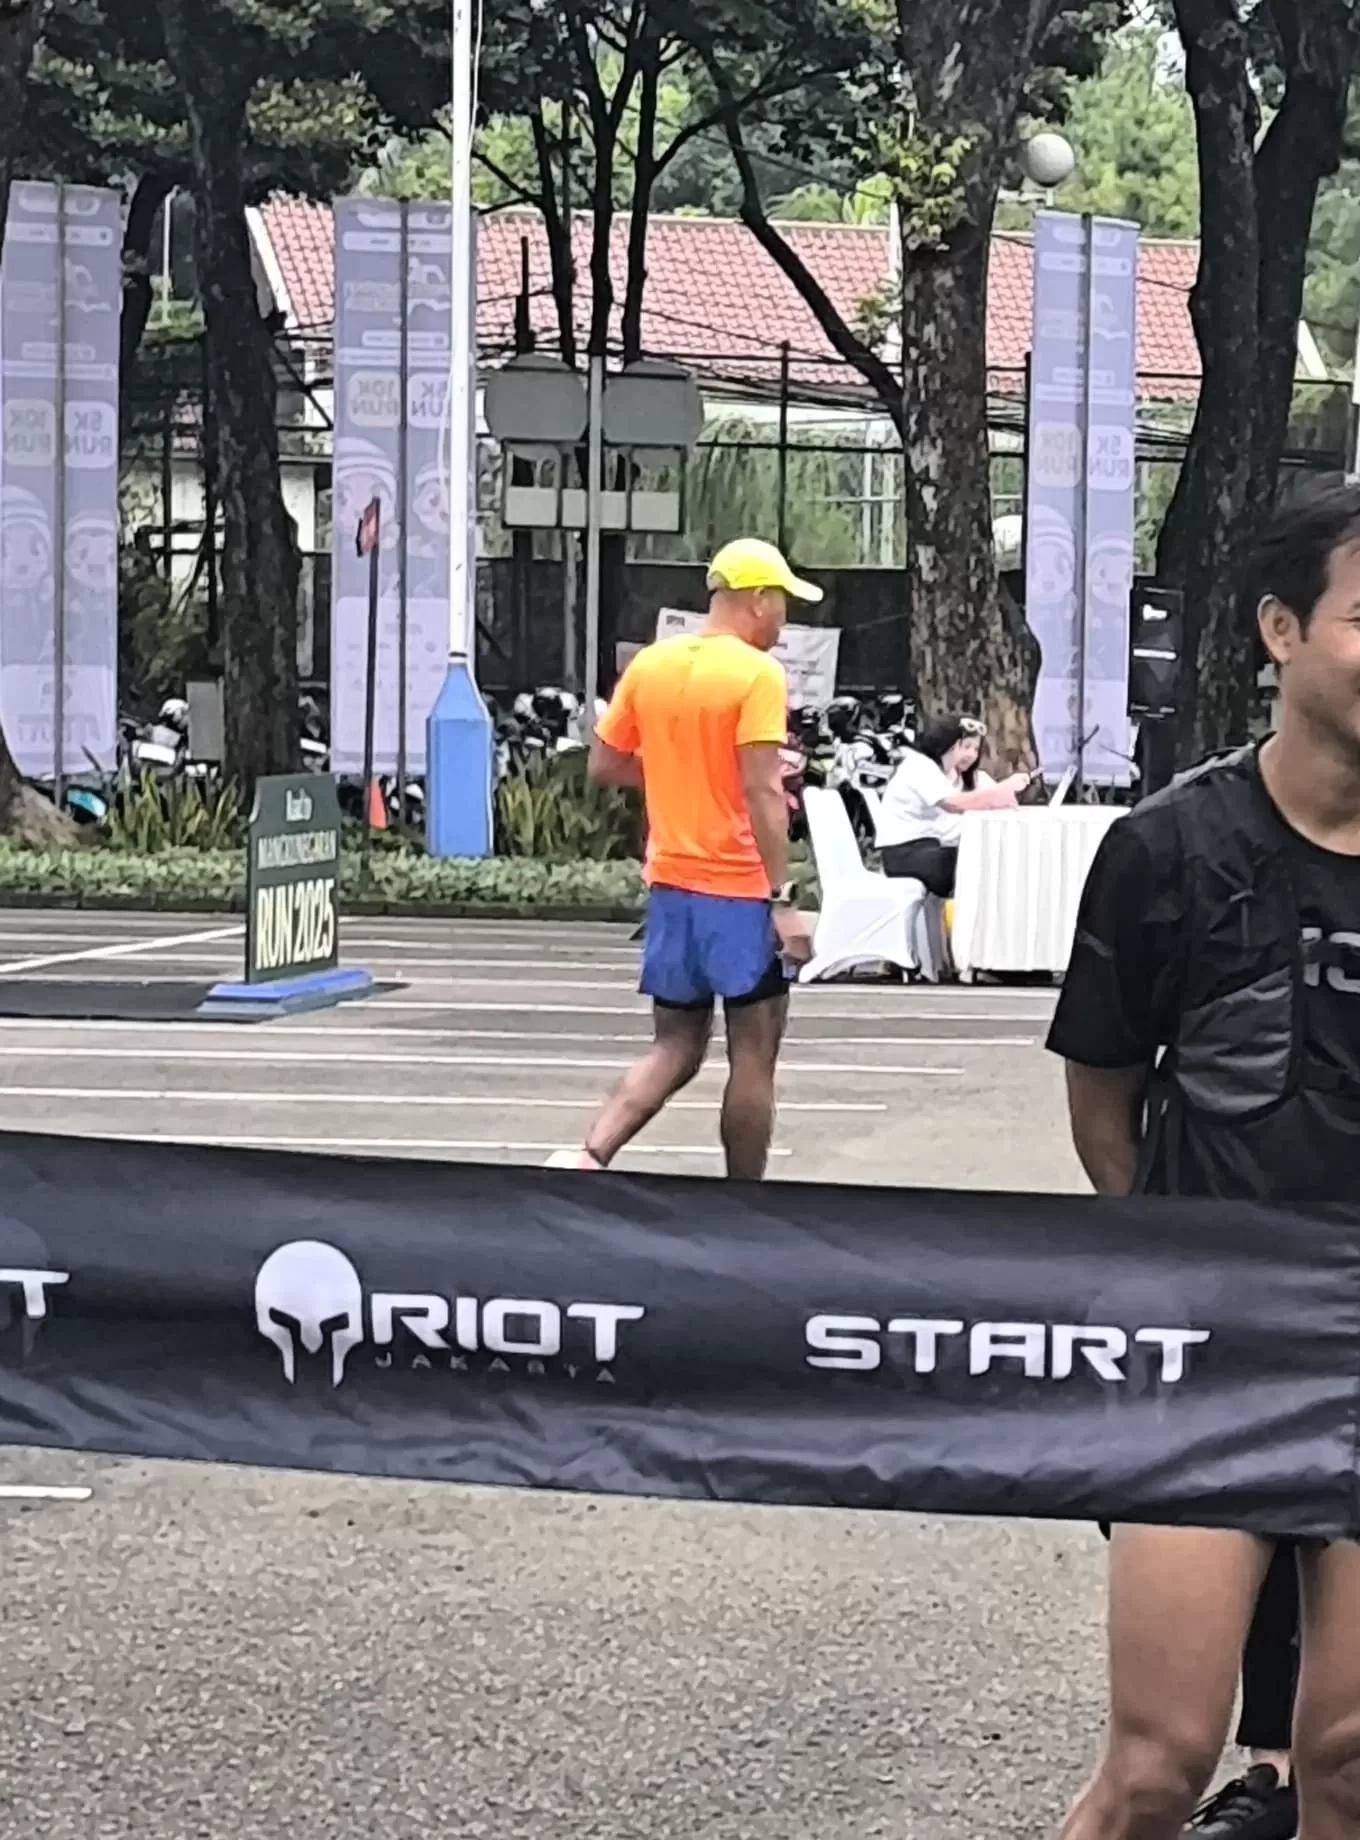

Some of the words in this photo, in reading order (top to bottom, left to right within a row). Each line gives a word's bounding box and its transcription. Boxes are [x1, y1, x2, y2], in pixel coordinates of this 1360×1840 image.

[256, 883, 294, 970] RUN
[294, 878, 335, 964] 2025
[371, 1293, 644, 1361] RIOT
[805, 1315, 1211, 1383] START
